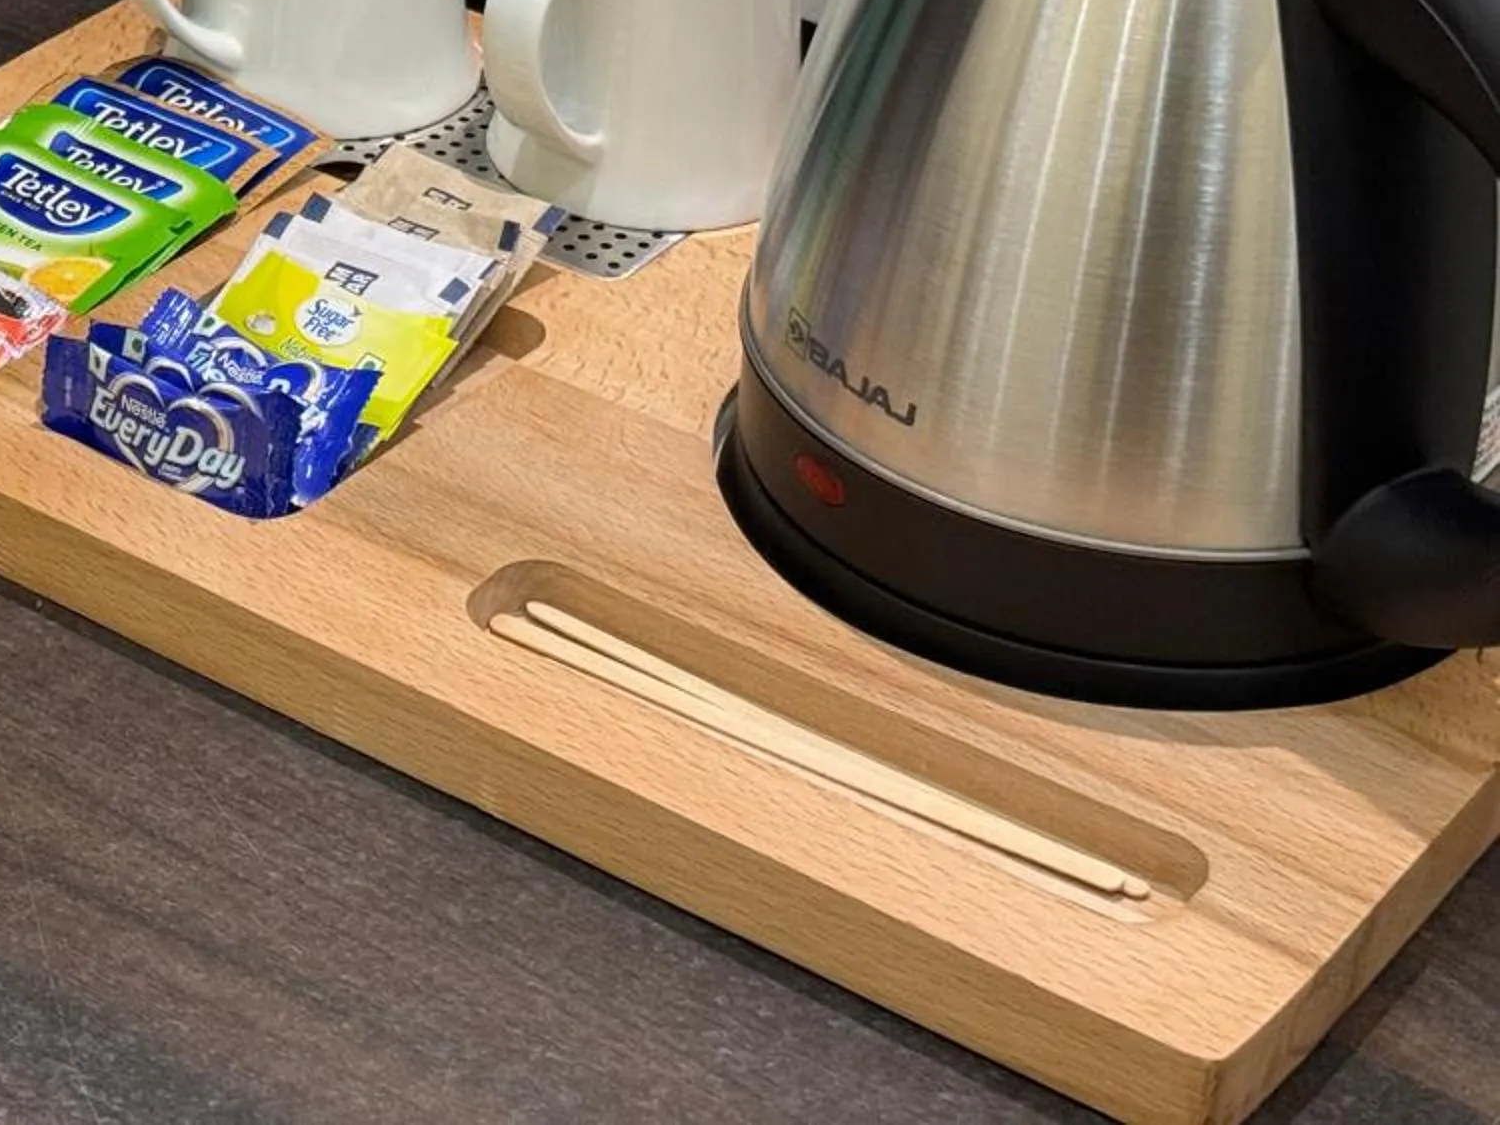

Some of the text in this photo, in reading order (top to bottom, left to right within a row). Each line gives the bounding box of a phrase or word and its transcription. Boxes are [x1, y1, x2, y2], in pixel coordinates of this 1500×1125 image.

[0, 162, 107, 227] Tetley
[18, 234, 42, 252] TEA
[303, 316, 336, 342] Free
[307, 298, 355, 329] Sugar
[809, 338, 917, 427] BAJAJ
